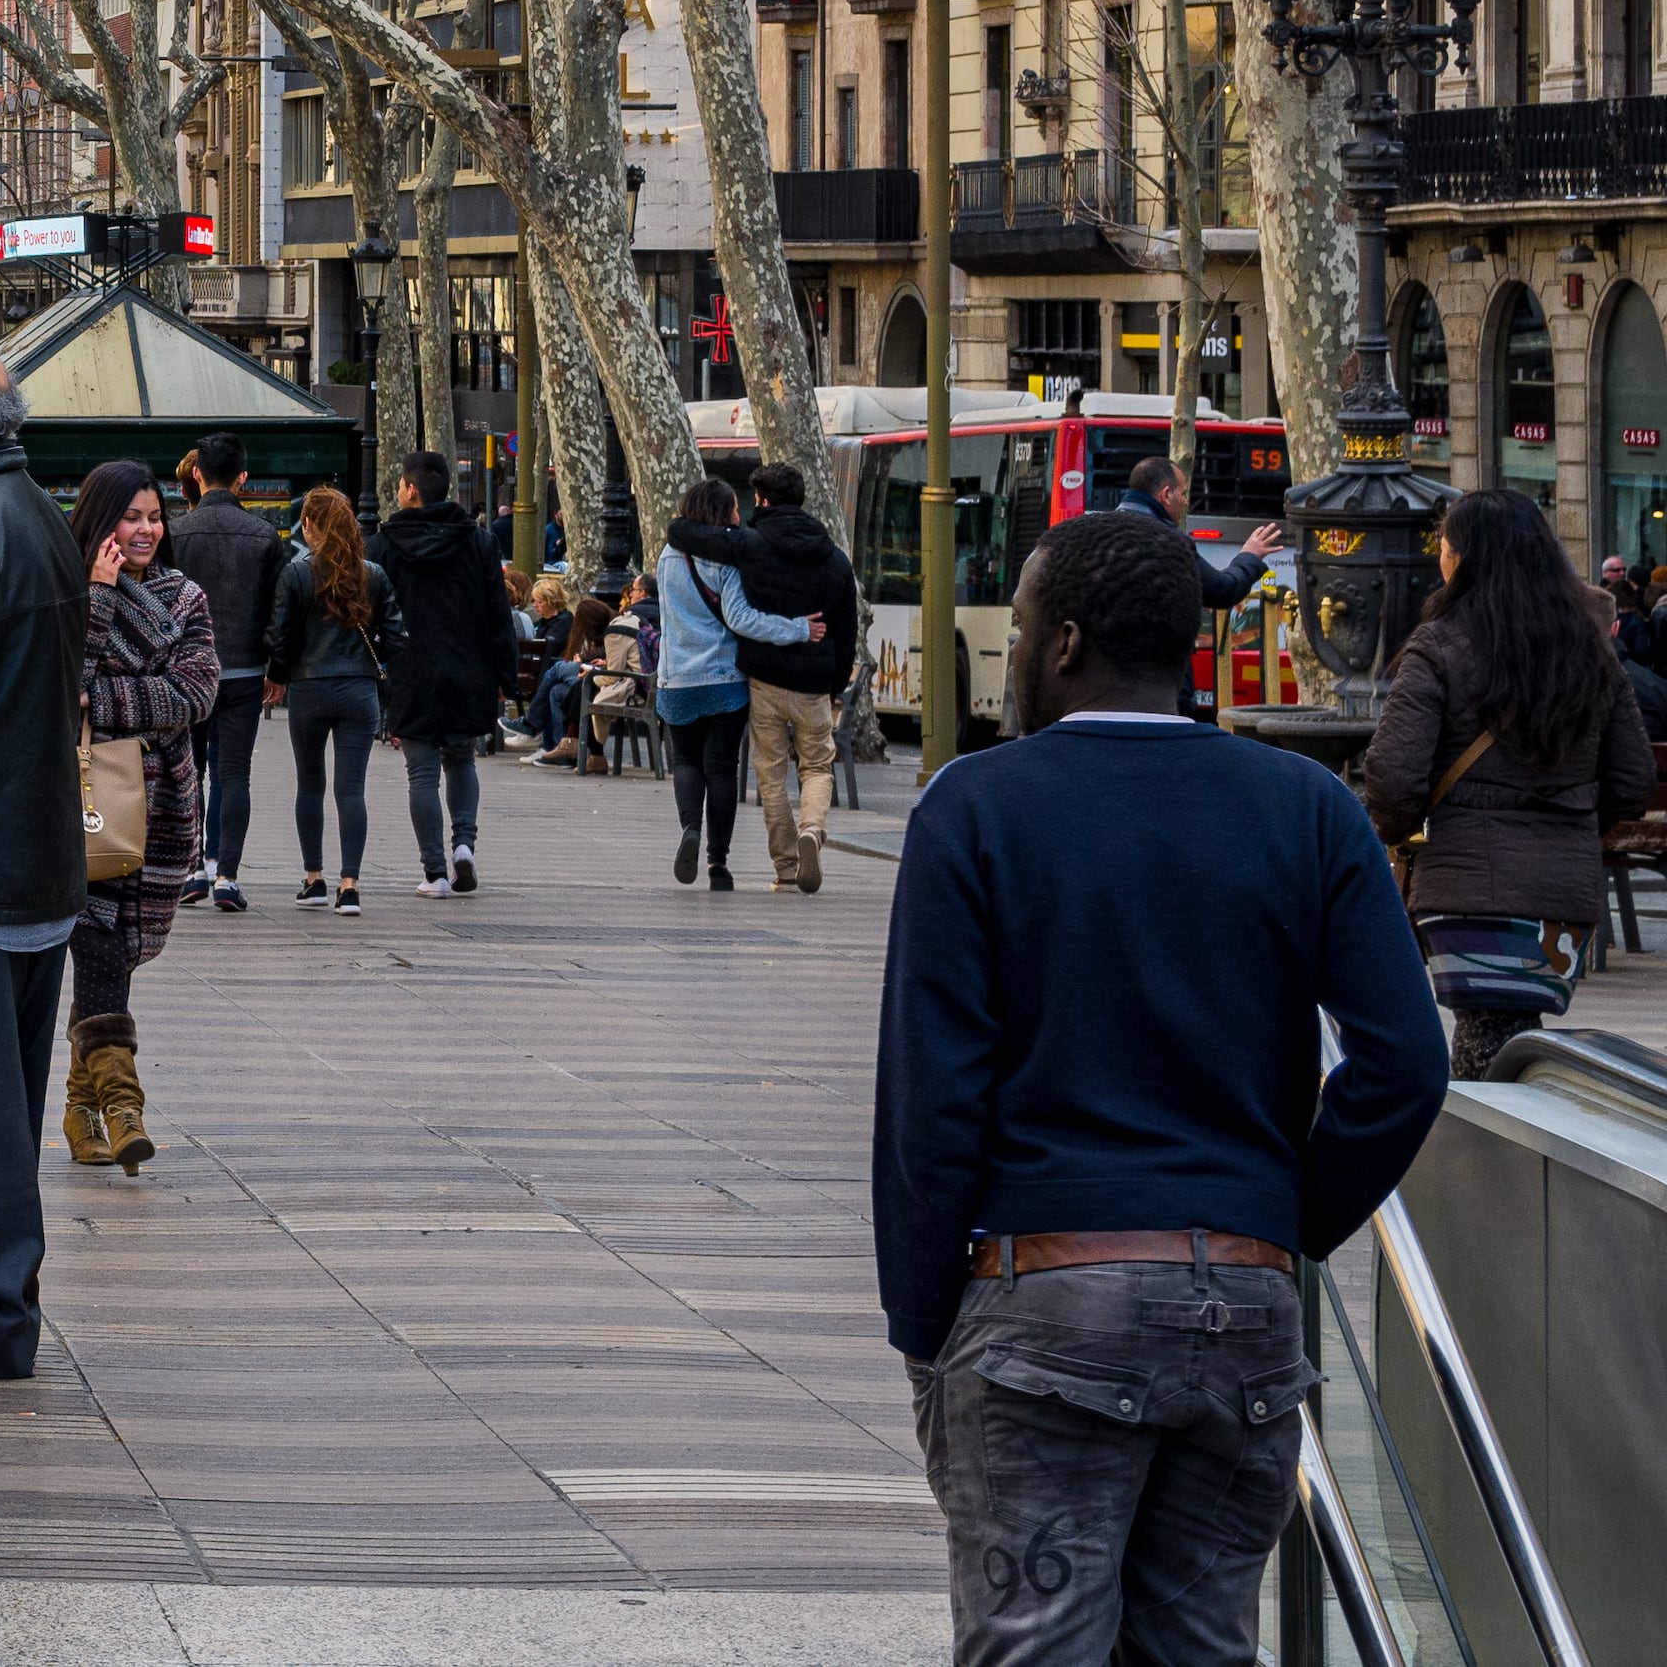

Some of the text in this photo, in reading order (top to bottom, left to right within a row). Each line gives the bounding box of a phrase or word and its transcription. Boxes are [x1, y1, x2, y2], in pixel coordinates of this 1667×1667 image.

[23, 229, 49, 247] Power
[50, 230, 59, 244] to
[60, 229, 77, 251] you
[1414, 420, 1443, 435] CASAS
[1513, 425, 1546, 441] CASAS
[1622, 429, 1657, 445] CASAS
[1014, 442, 1032, 462] 6370
[1250, 449, 1283, 471] 59
[982, 1511, 1073, 1617] 96
